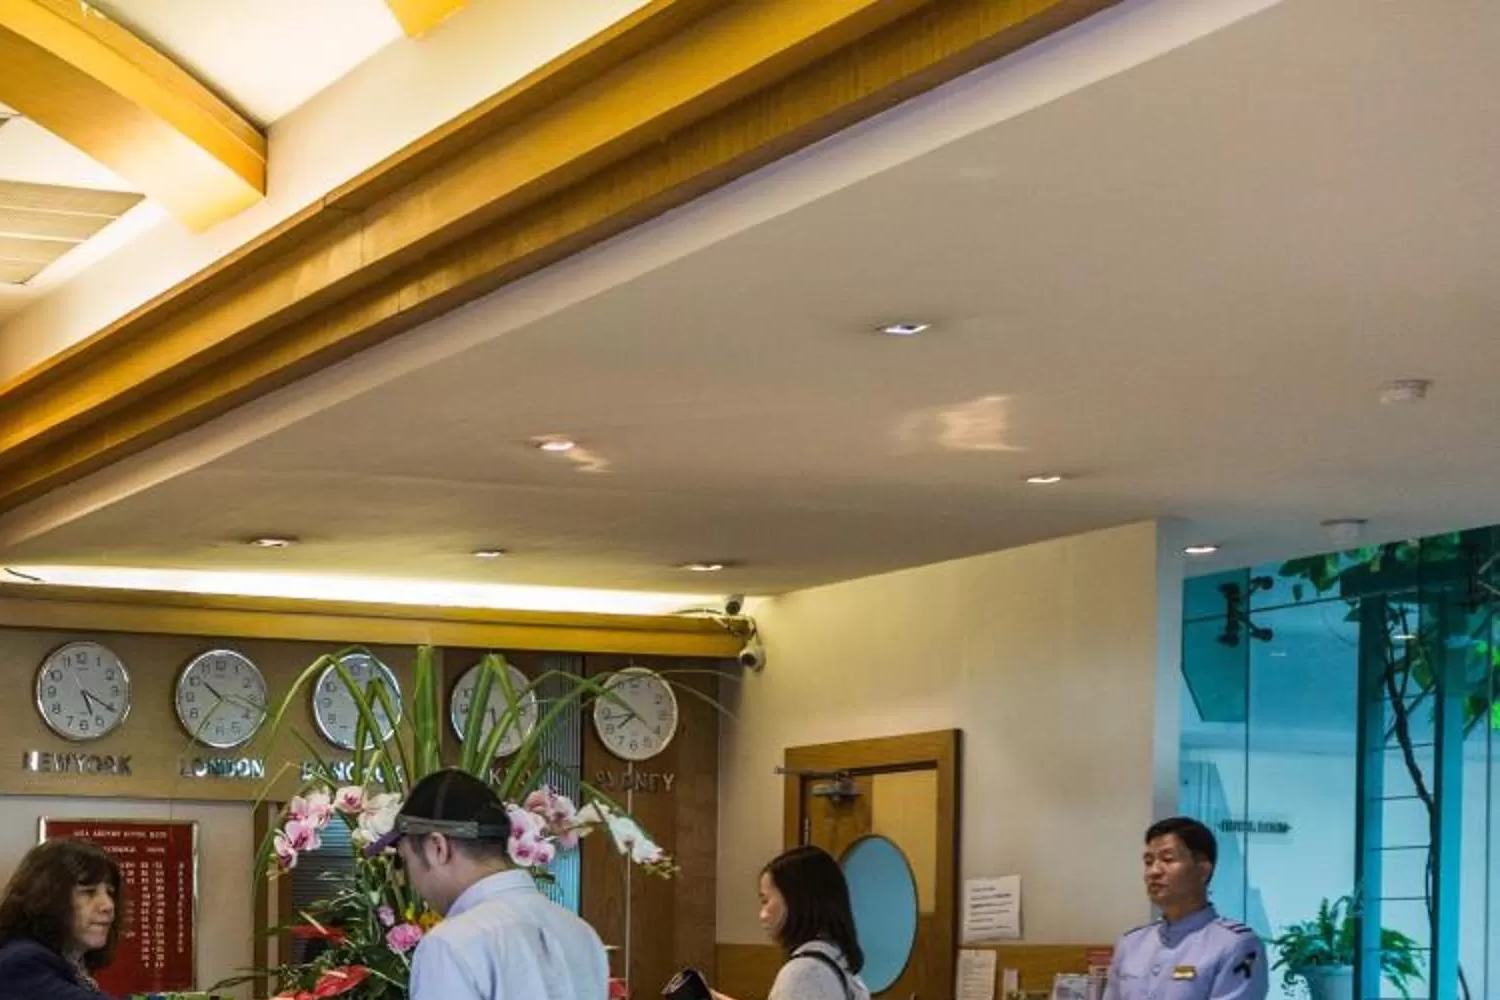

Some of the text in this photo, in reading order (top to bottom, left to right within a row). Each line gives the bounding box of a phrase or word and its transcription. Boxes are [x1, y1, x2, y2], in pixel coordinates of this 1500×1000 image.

[75, 651, 87, 665] 12
[48, 668, 63, 682] 10
[105, 668, 115, 681] 2
[243, 677, 253, 689] 2
[47, 685, 57, 697] 9
[51, 703, 62, 714] 8
[66, 715, 75, 728] 7
[180, 757, 265, 778] LONDON
